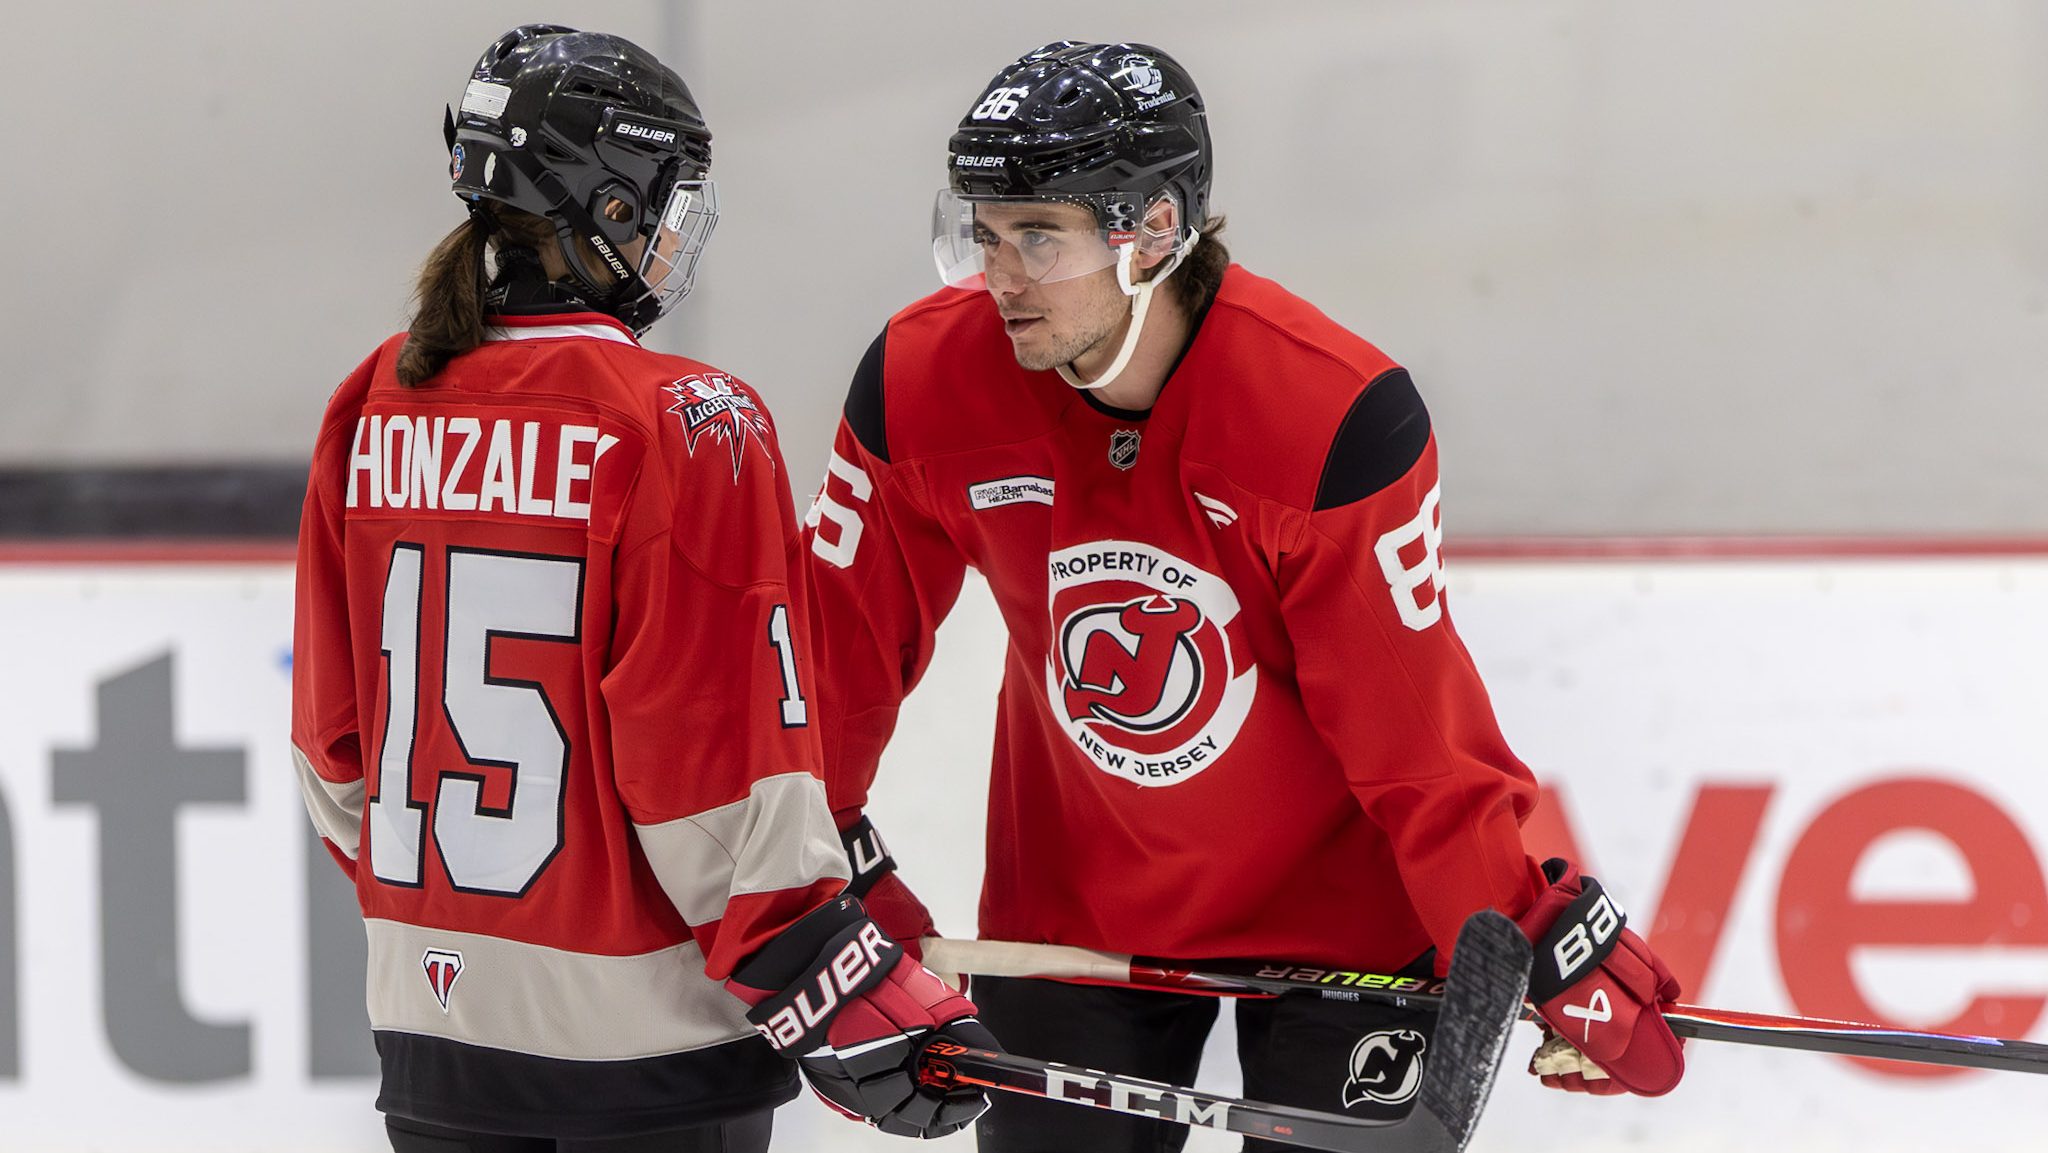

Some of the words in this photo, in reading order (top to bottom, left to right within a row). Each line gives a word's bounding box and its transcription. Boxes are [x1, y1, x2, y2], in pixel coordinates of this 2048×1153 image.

[972, 87, 1030, 120] 86
[616, 123, 675, 143] BAUER
[956, 155, 1005, 167] BAUER
[590, 235, 629, 280] BAUER
[1116, 441, 1135, 461] NHL
[988, 492, 1024, 503] HEALTH
[1051, 552, 1159, 582] PROPERTY
[1162, 567, 1197, 589] OF
[370, 541, 586, 898] 15
[1079, 731, 1126, 770] NEW
[1134, 735, 1217, 778] JERSEY
[1043, 1067, 1231, 1131] CCM
